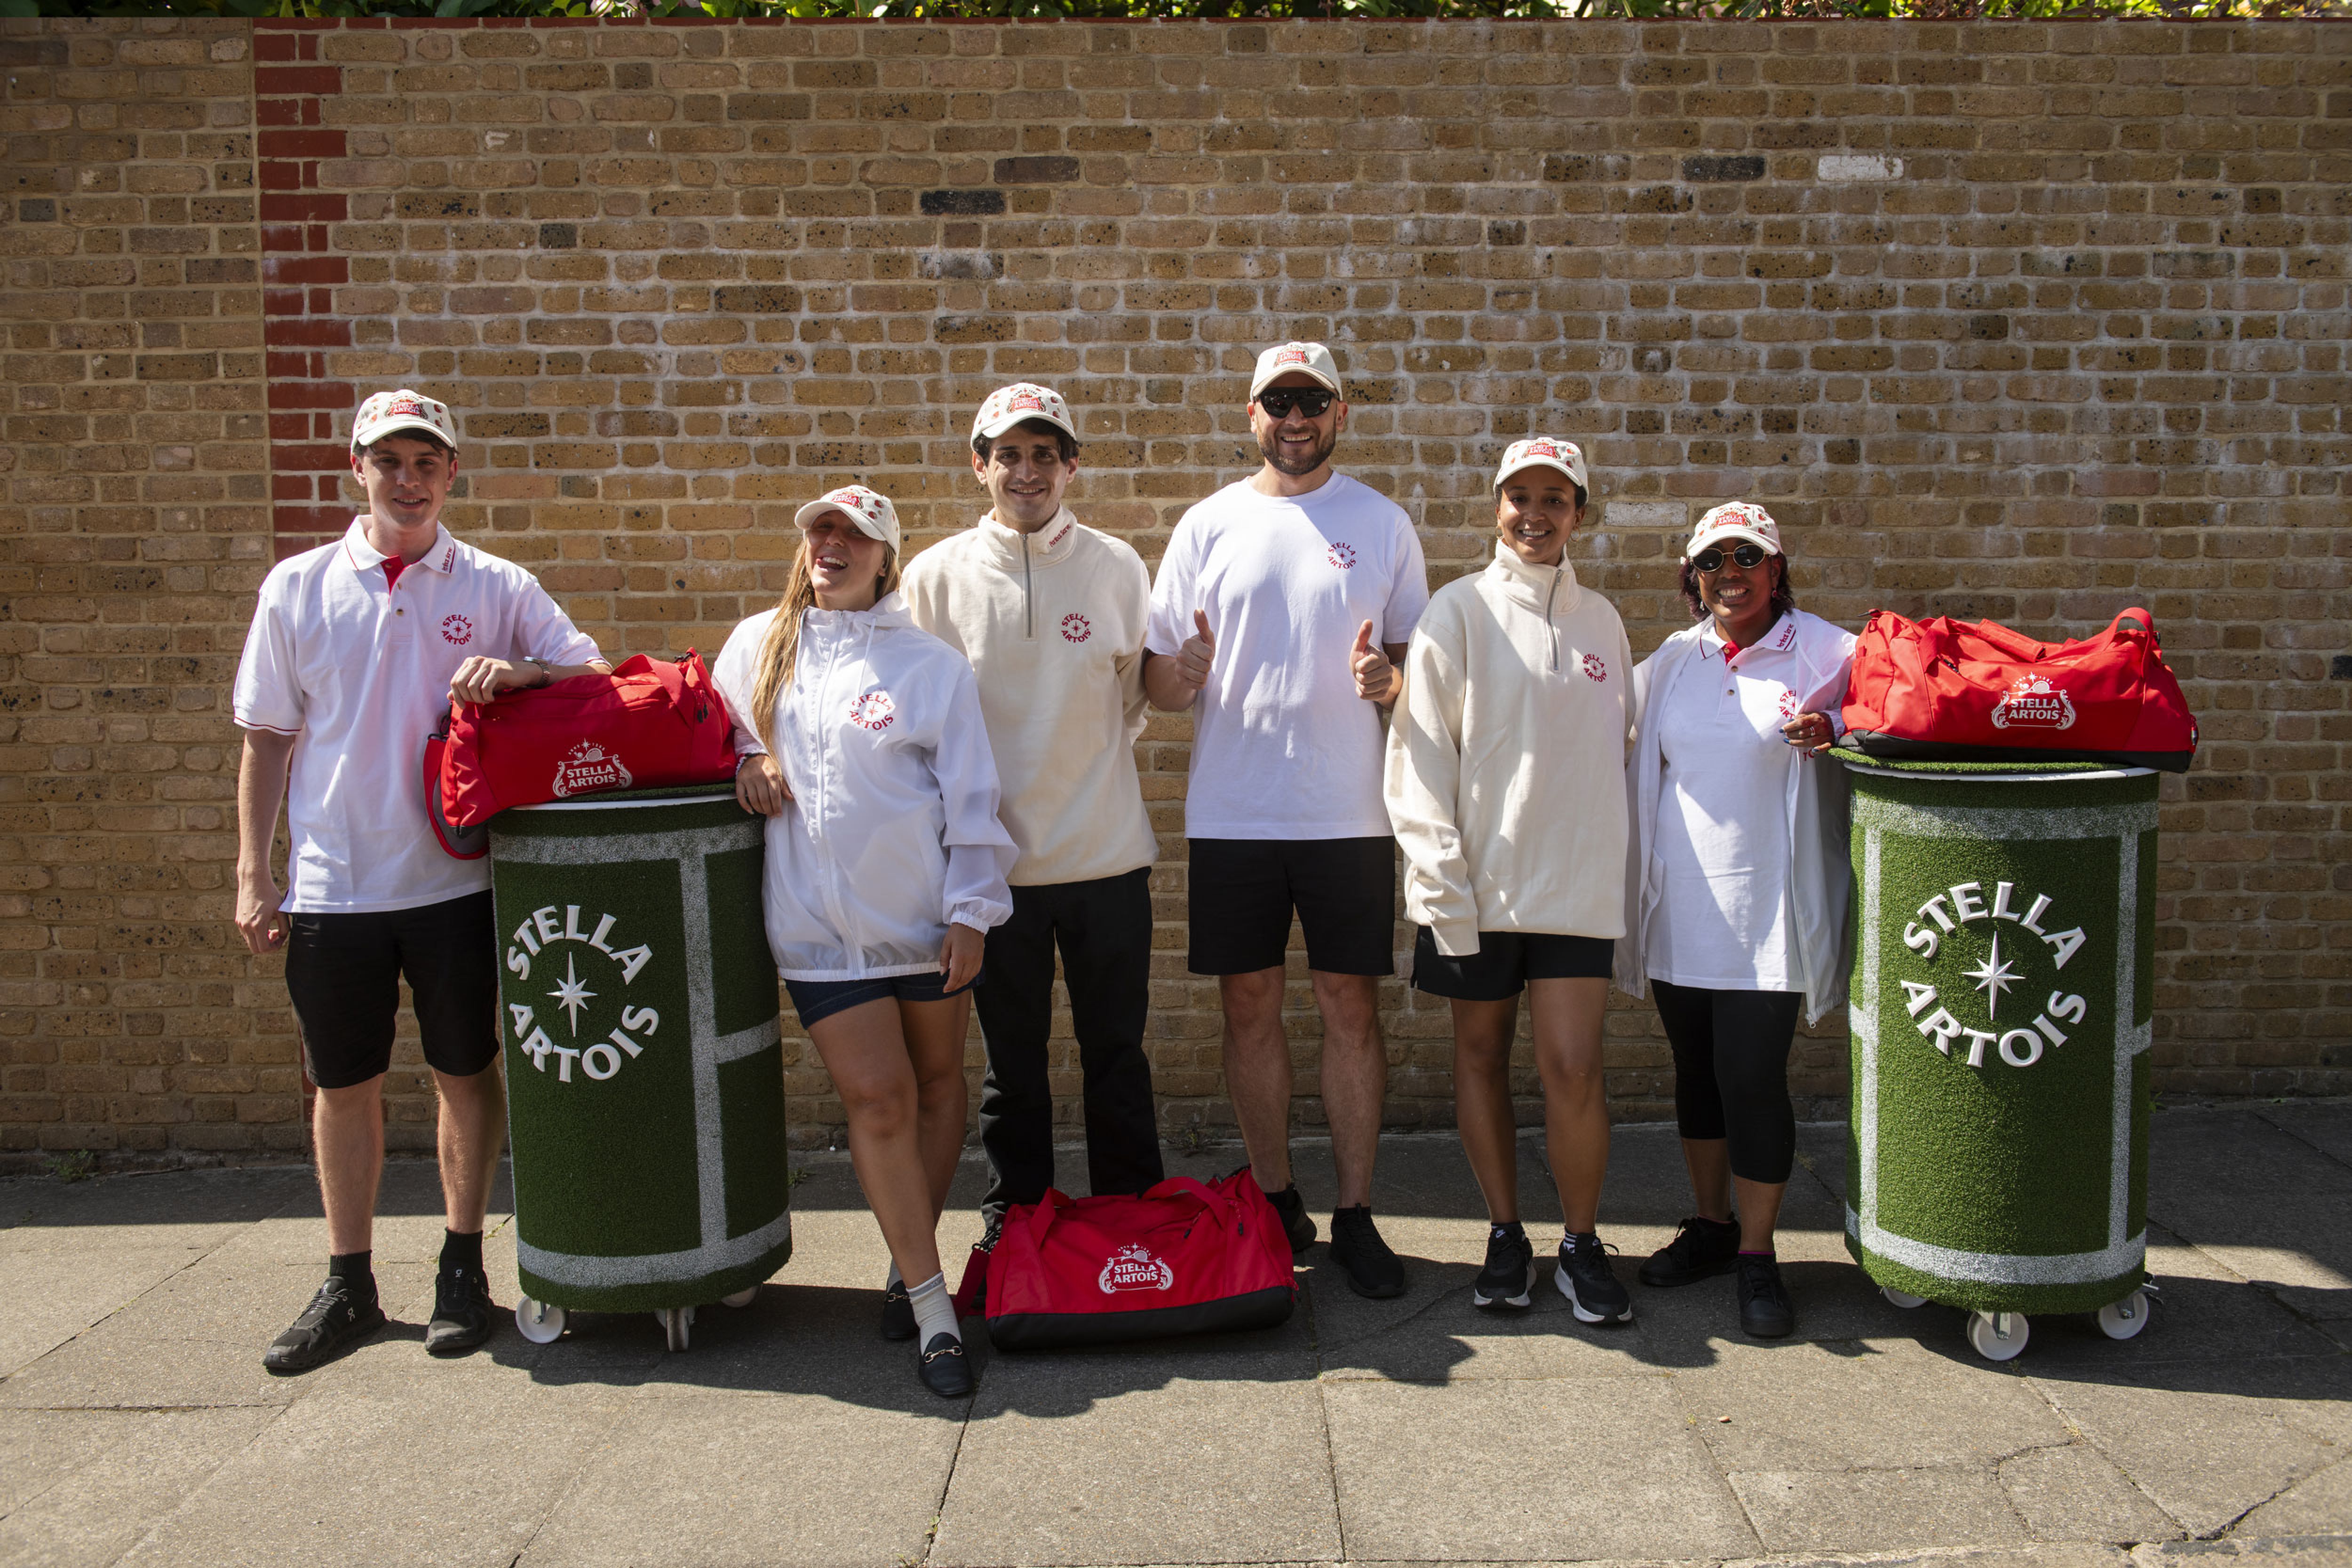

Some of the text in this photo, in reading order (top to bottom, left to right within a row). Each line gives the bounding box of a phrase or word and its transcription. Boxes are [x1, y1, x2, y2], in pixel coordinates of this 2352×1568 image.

[443, 614, 472, 629] STELLA
[1062, 613, 1090, 627] STELLA
[441, 631, 472, 645] ARTOIS
[1061, 630, 1091, 643] ARTOIS
[2010, 698, 2060, 709] STELLA
[850, 711, 893, 730] ARTOIS
[2008, 709, 2059, 720] ARTOIS
[567, 764, 614, 778] STELLA
[568, 774, 616, 788] ARTOIS
[1904, 881, 2087, 970] STELLA
[507, 905, 653, 985] STELLA
[1900, 980, 2087, 1068] ARTOIS
[509, 1003, 659, 1083] ARTOIS
[1114, 1263, 1157, 1273] STELLA
[1113, 1271, 1158, 1283] ARTOIS
